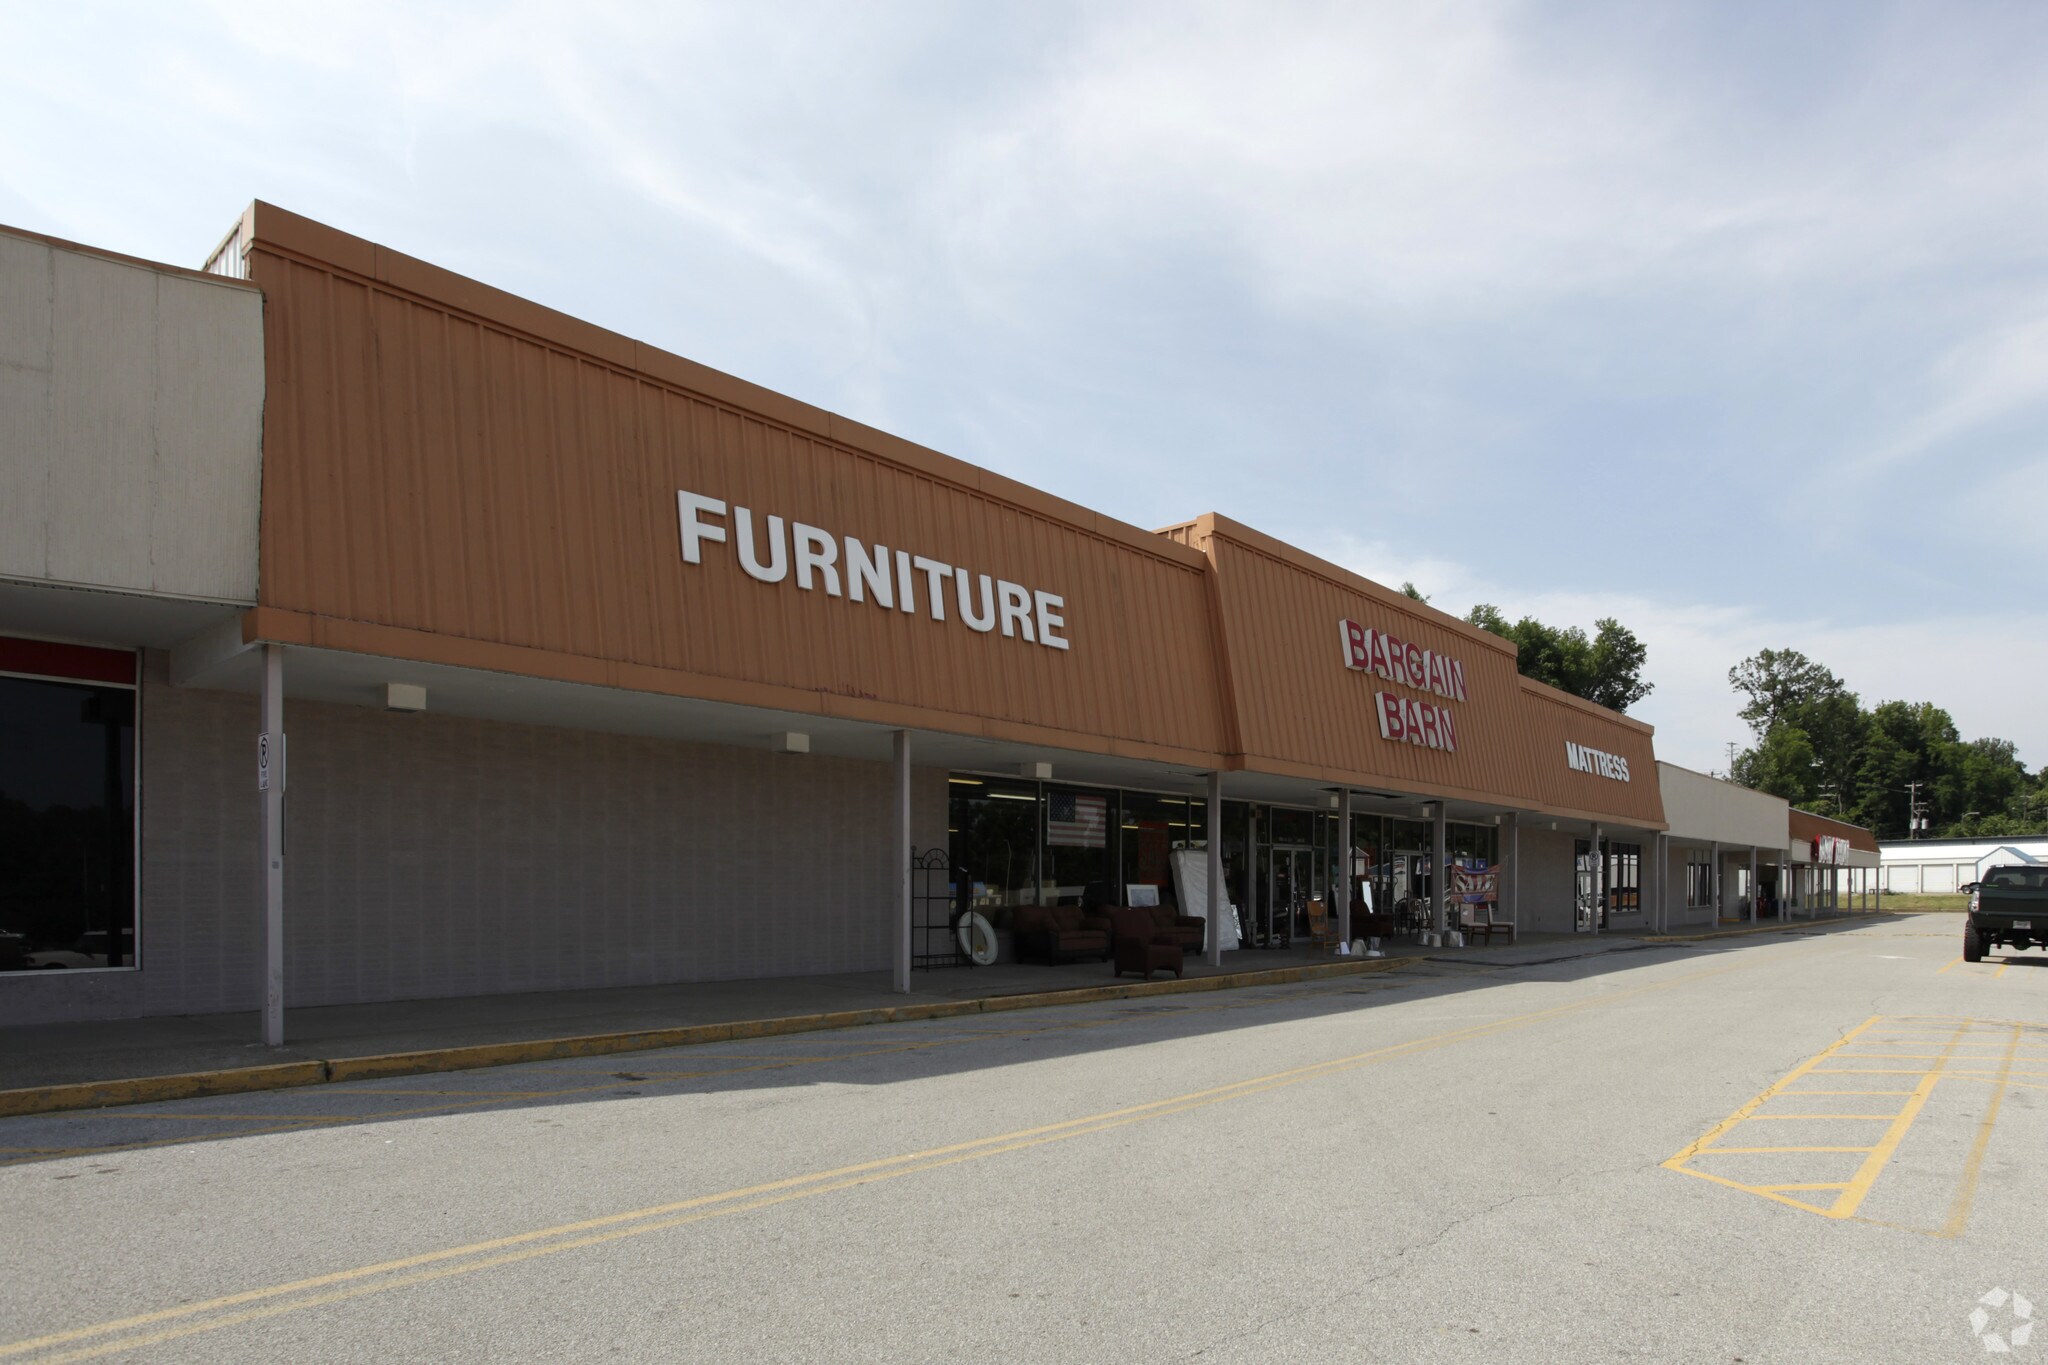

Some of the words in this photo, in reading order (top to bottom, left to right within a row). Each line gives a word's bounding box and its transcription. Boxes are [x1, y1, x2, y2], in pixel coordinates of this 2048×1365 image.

[677, 489, 1070, 651] FURNITURE
[1339, 618, 1468, 702] BARGAIN
[1375, 691, 1458, 752] BARN
[1565, 741, 1631, 783] MATTRESS
[1455, 873, 1496, 893] SALE
